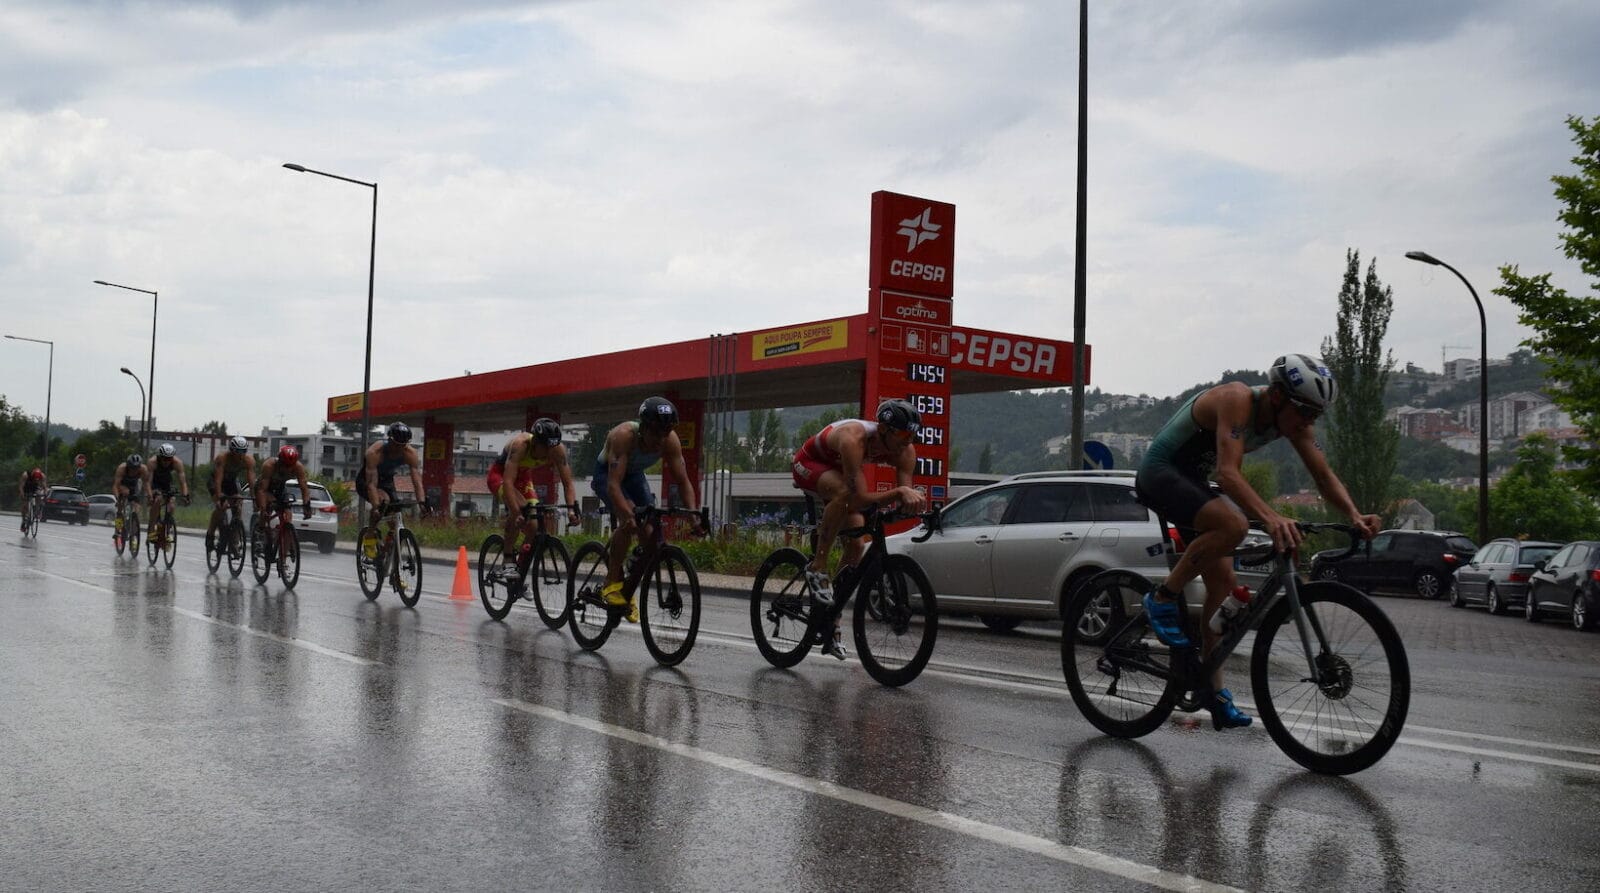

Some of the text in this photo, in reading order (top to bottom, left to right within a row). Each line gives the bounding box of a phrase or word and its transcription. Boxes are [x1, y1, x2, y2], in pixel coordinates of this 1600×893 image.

[890, 259, 946, 283] CEPSA
[896, 304, 938, 319] optima
[781, 331, 801, 342] POUPA
[951, 331, 1057, 374] CEPSA
[912, 364, 945, 383] 1454
[911, 395, 944, 414] 1639
[917, 427, 943, 445] 494
[917, 457, 942, 475] 771
